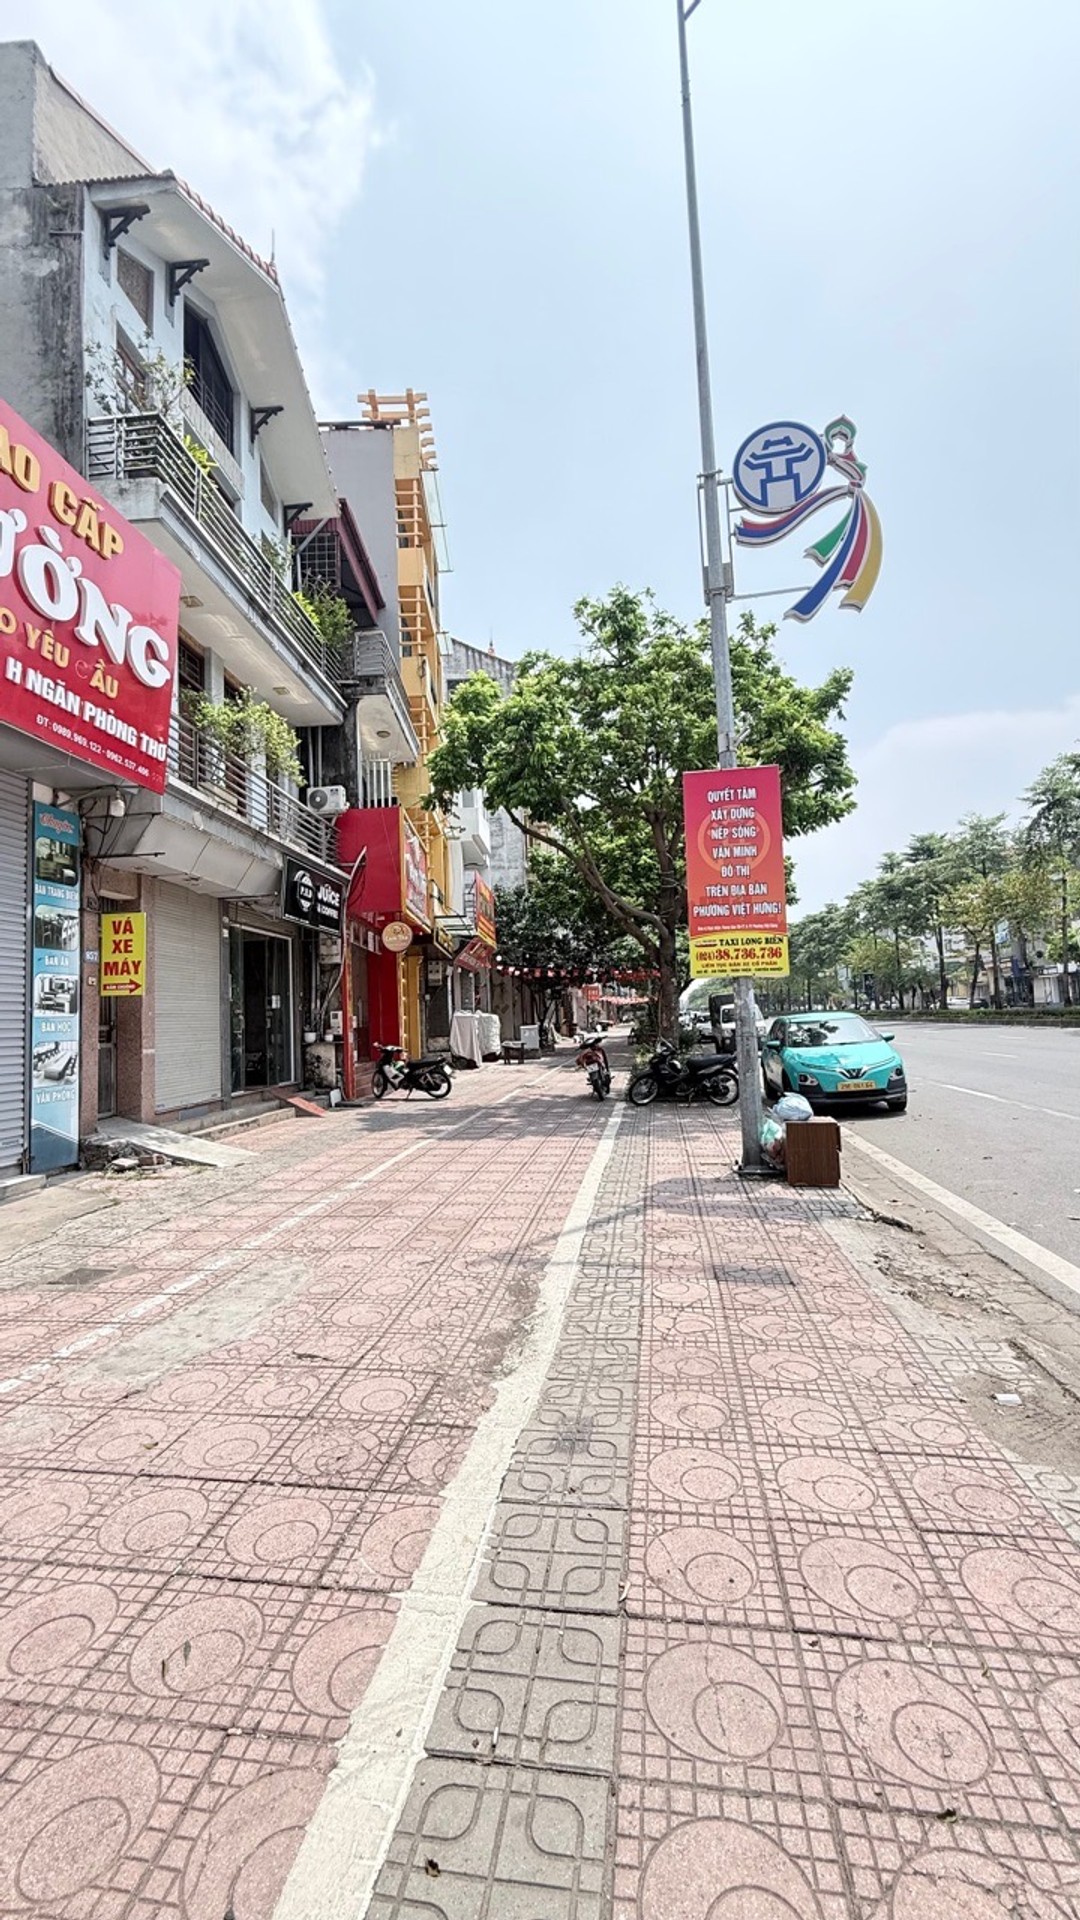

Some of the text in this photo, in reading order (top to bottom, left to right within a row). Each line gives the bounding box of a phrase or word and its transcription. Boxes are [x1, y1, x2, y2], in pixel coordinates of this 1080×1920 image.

[24, 622, 70, 668] YÊU
[82, 700, 138, 748] PHÒNG
[707, 786, 757, 803] QUYẾT TÂM
[710, 806, 756, 822] XÂY DỰNG
[710, 824, 757, 840] NẾP SỐNG
[712, 844, 758, 859] VĂN MINH
[721, 863, 750, 879] ĐÔ THỊ
[705, 881, 768, 898] TRÊN ĐỊA BÀN
[693, 901, 730, 917] PHƯỜNG
[731, 901, 751, 918] VIỆT
[111, 916, 134, 935] VÁ
[111, 939, 134, 955] XE
[719, 938, 740, 947] TAXI
[740, 937, 763, 946] LONG
[764, 934, 784, 945] BIÊN
[103, 957, 142, 977] MÁY
